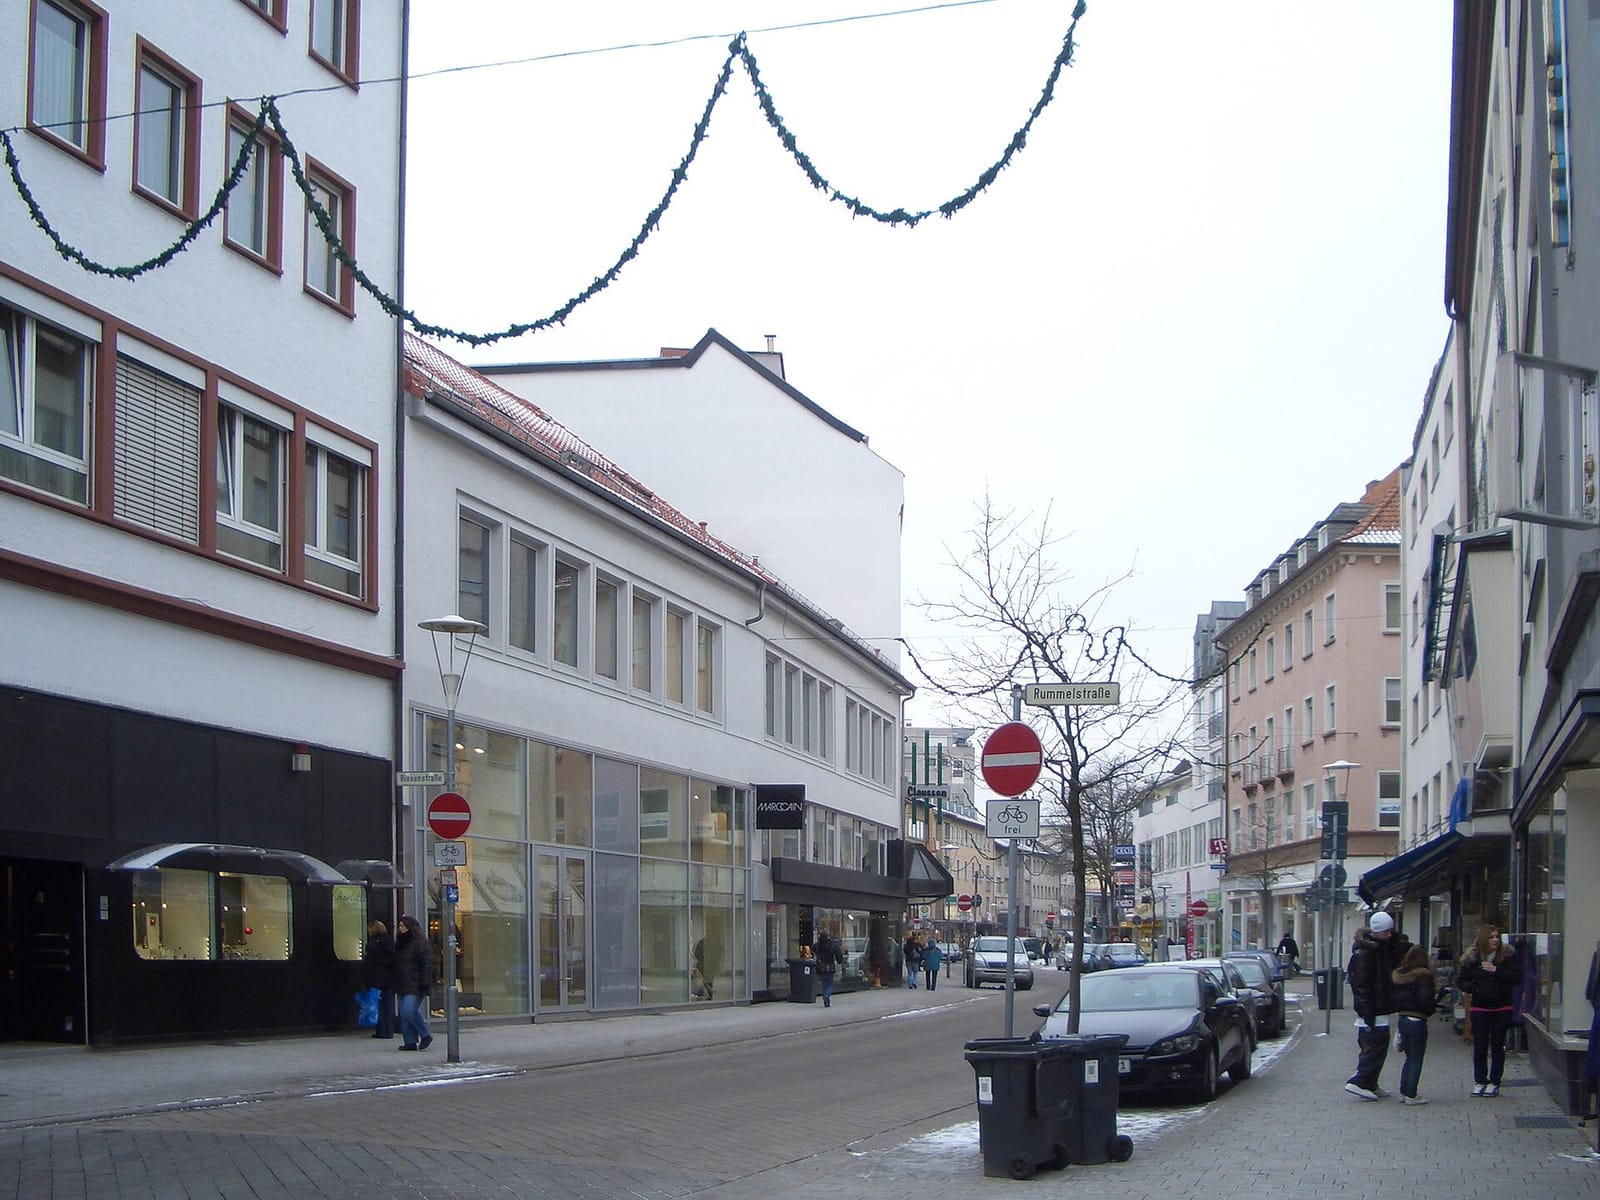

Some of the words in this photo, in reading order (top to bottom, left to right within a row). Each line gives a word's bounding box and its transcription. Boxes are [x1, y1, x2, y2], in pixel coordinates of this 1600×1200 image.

[1033, 687, 1111, 701] Rummelstraße
[400, 773, 443, 783] Riesenstraße
[907, 786, 947, 797] Claussen
[1004, 825, 1021, 835] frei
